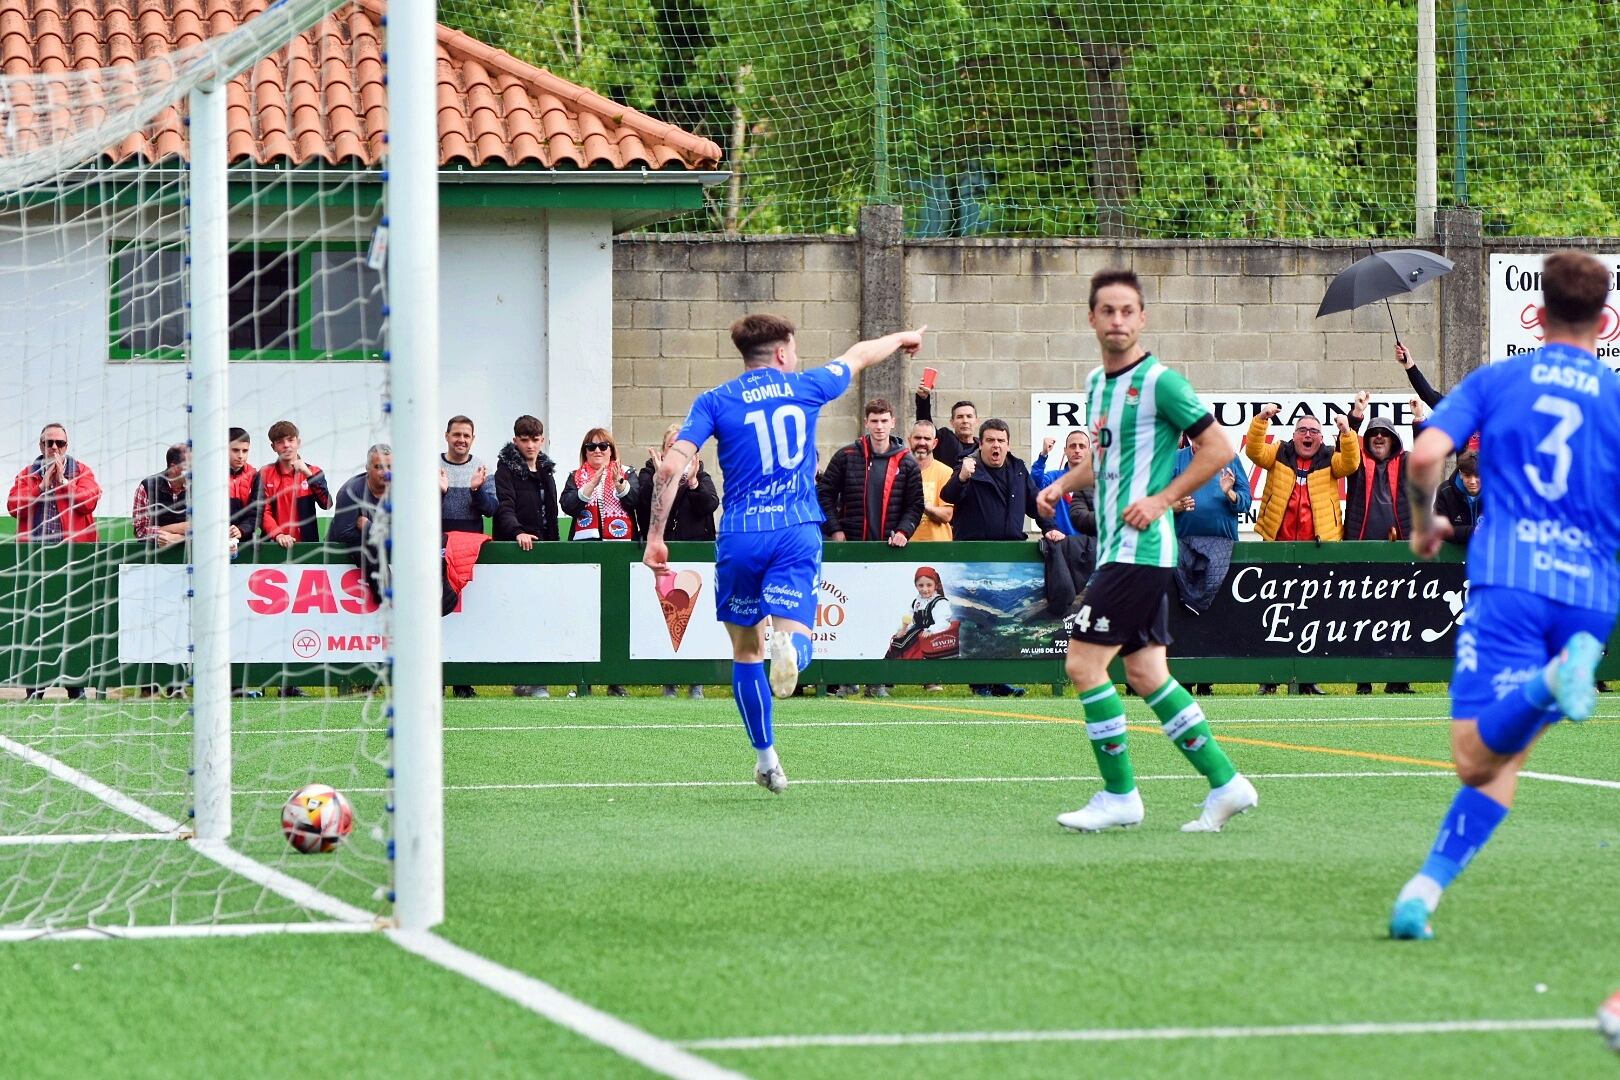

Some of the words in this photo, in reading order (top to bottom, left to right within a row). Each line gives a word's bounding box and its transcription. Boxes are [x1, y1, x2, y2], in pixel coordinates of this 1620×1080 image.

[742, 383, 794, 404] GOMILA
[1530, 363, 1600, 397] CASTA
[744, 405, 806, 476] 10
[1523, 393, 1584, 501] 3
[1231, 566, 1440, 610] Carpintería
[1262, 602, 1413, 654] Eguren
